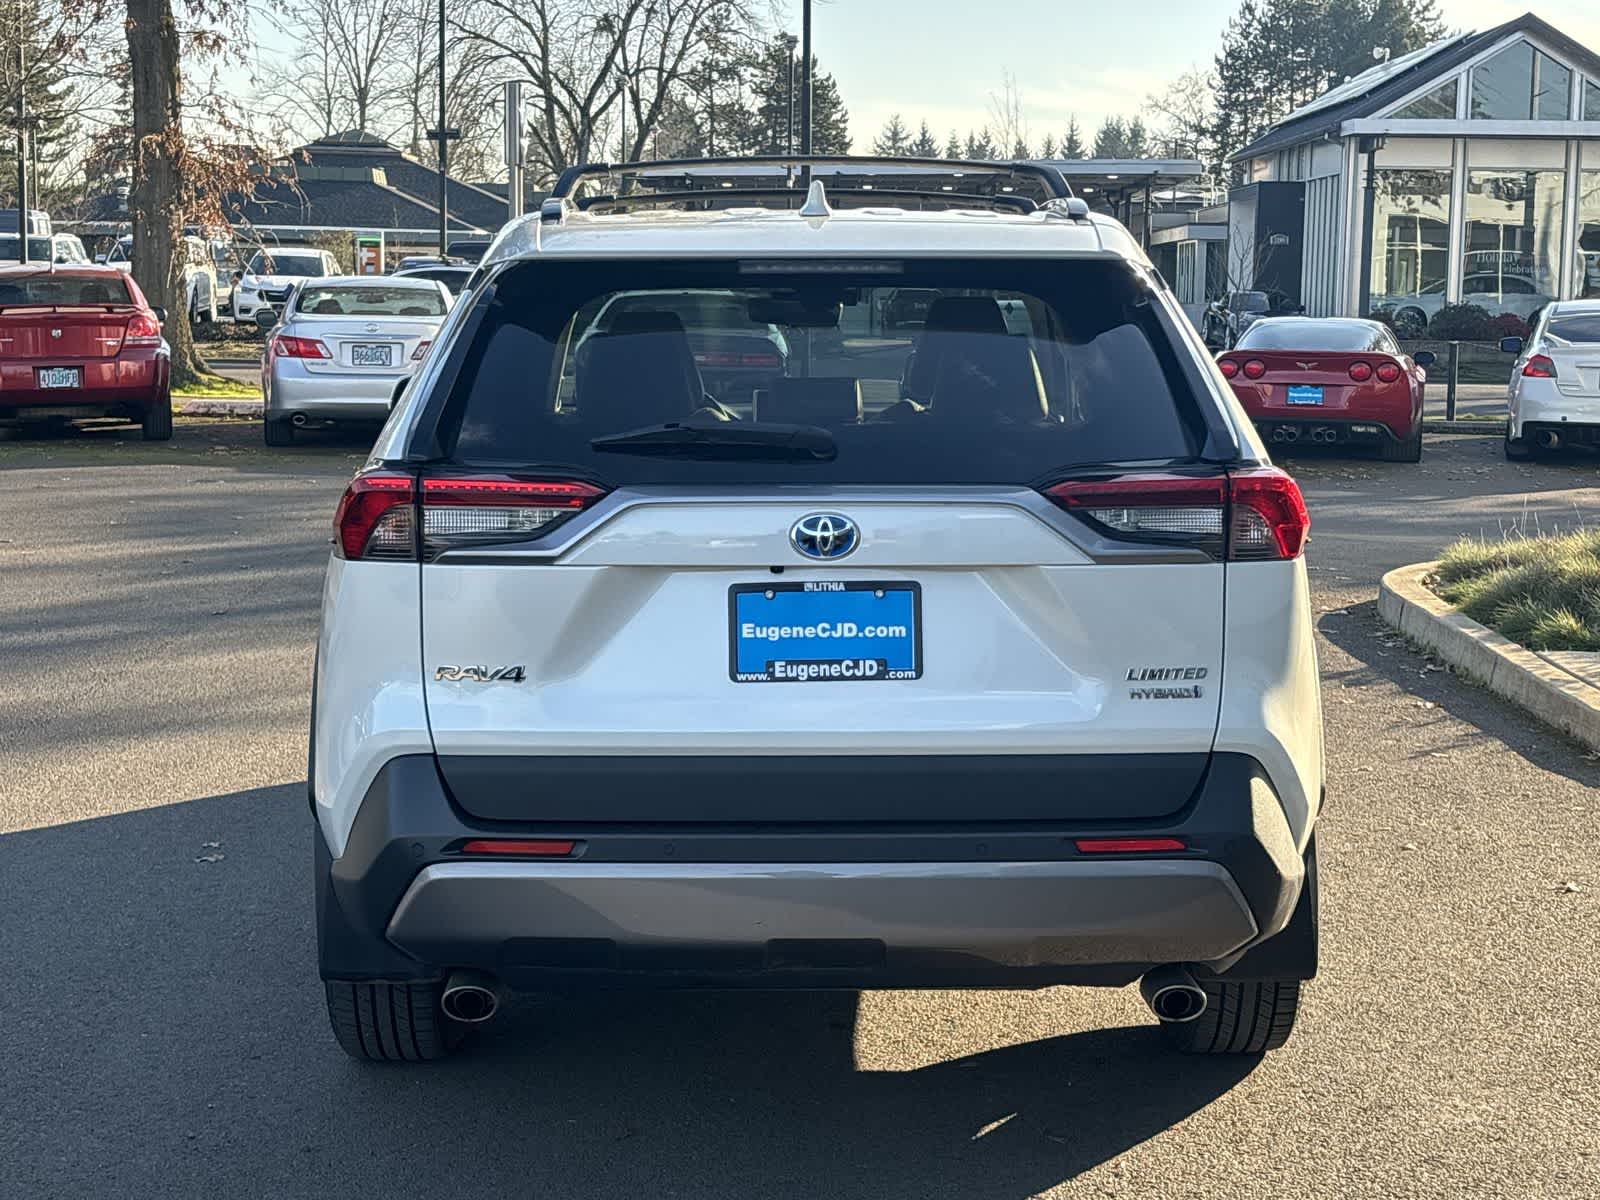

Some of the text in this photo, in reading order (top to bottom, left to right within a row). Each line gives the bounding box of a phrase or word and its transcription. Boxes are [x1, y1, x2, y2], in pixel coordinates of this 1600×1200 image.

[814, 582, 846, 592] LITHIA
[742, 622, 906, 641] EugeneCJD.com
[434, 664, 527, 683] RAV4
[736, 659, 916, 681] www. EugeneCJD .com
[1125, 667, 1208, 681] LIMITED
